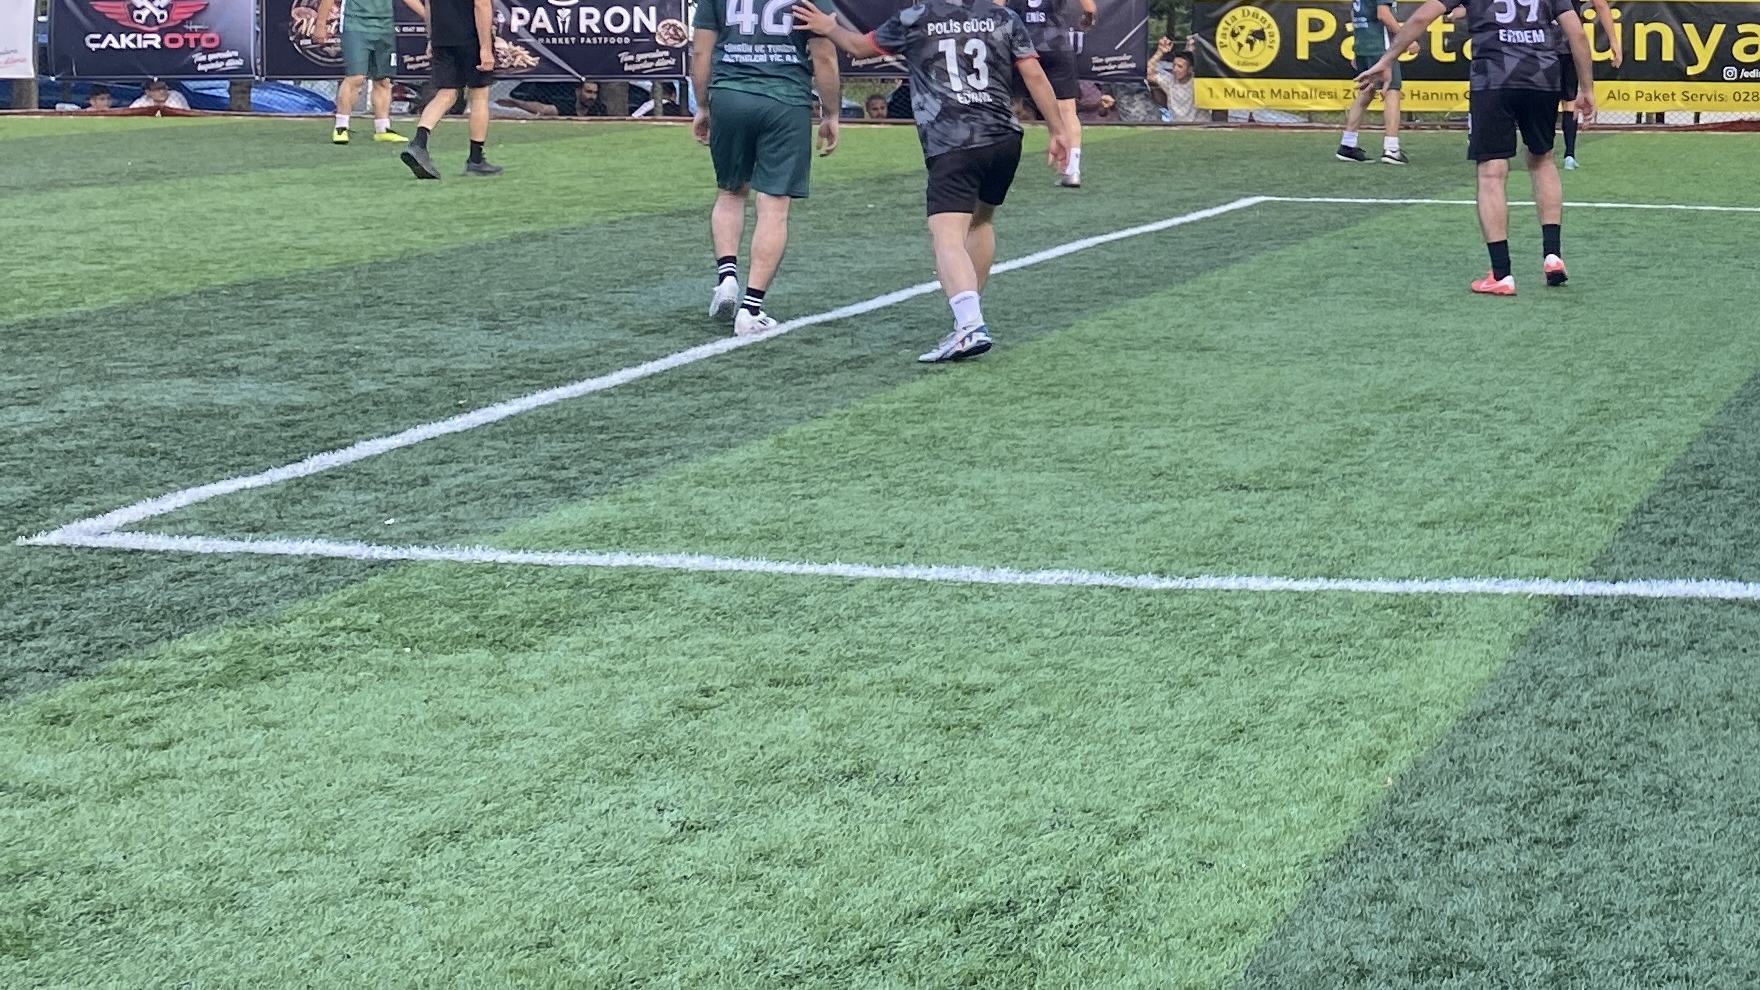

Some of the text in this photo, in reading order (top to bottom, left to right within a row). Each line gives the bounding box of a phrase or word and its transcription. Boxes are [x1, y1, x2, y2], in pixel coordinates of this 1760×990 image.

[927, 17, 995, 36] POLİS GÜCÜ
[85, 32, 221, 51] ÇAKIR OTO
[1499, 28, 1545, 43] ERDEM
[938, 38, 990, 92] 13
[1224, 88, 1266, 100] Murat
[1270, 87, 1338, 101] Mahallesi
[1410, 89, 1459, 101] Hanım
[1607, 89, 1630, 102] Alo
[1635, 90, 1676, 102] Paket
